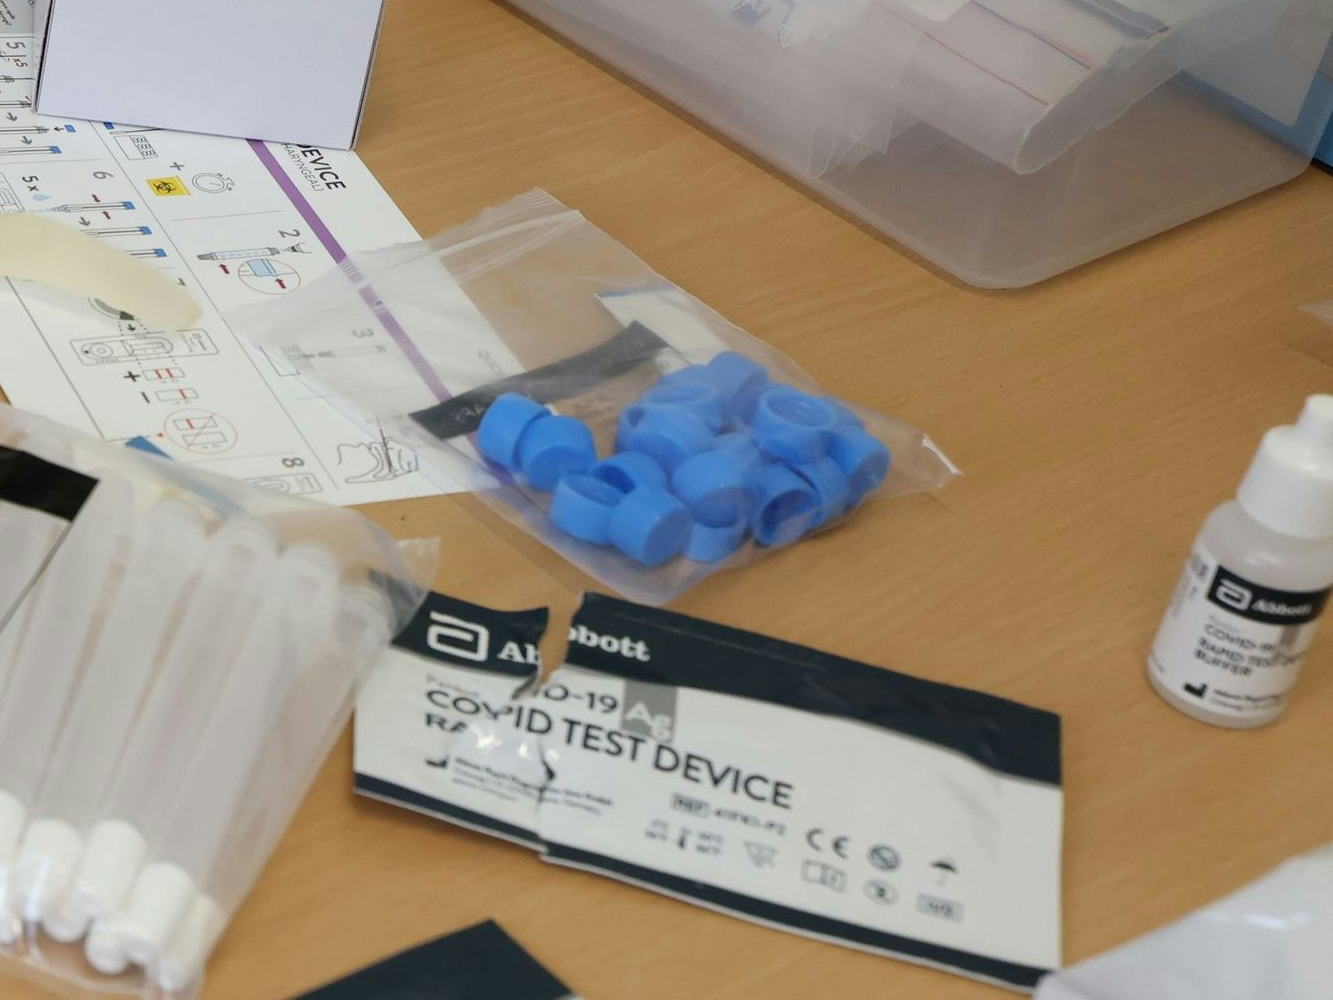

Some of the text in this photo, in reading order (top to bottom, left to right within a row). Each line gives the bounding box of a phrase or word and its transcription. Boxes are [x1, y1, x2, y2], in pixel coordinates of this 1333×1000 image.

[296, 144, 347, 190] EVICE
[22, 175, 39, 183] 5
[278, 229, 301, 238] 2
[282, 457, 304, 468] 8
[1250, 599, 1312, 616] Abbott
[623, 703, 673, 741] Ag
[562, 718, 646, 762] TEST
[653, 744, 796, 810] DEVICE
